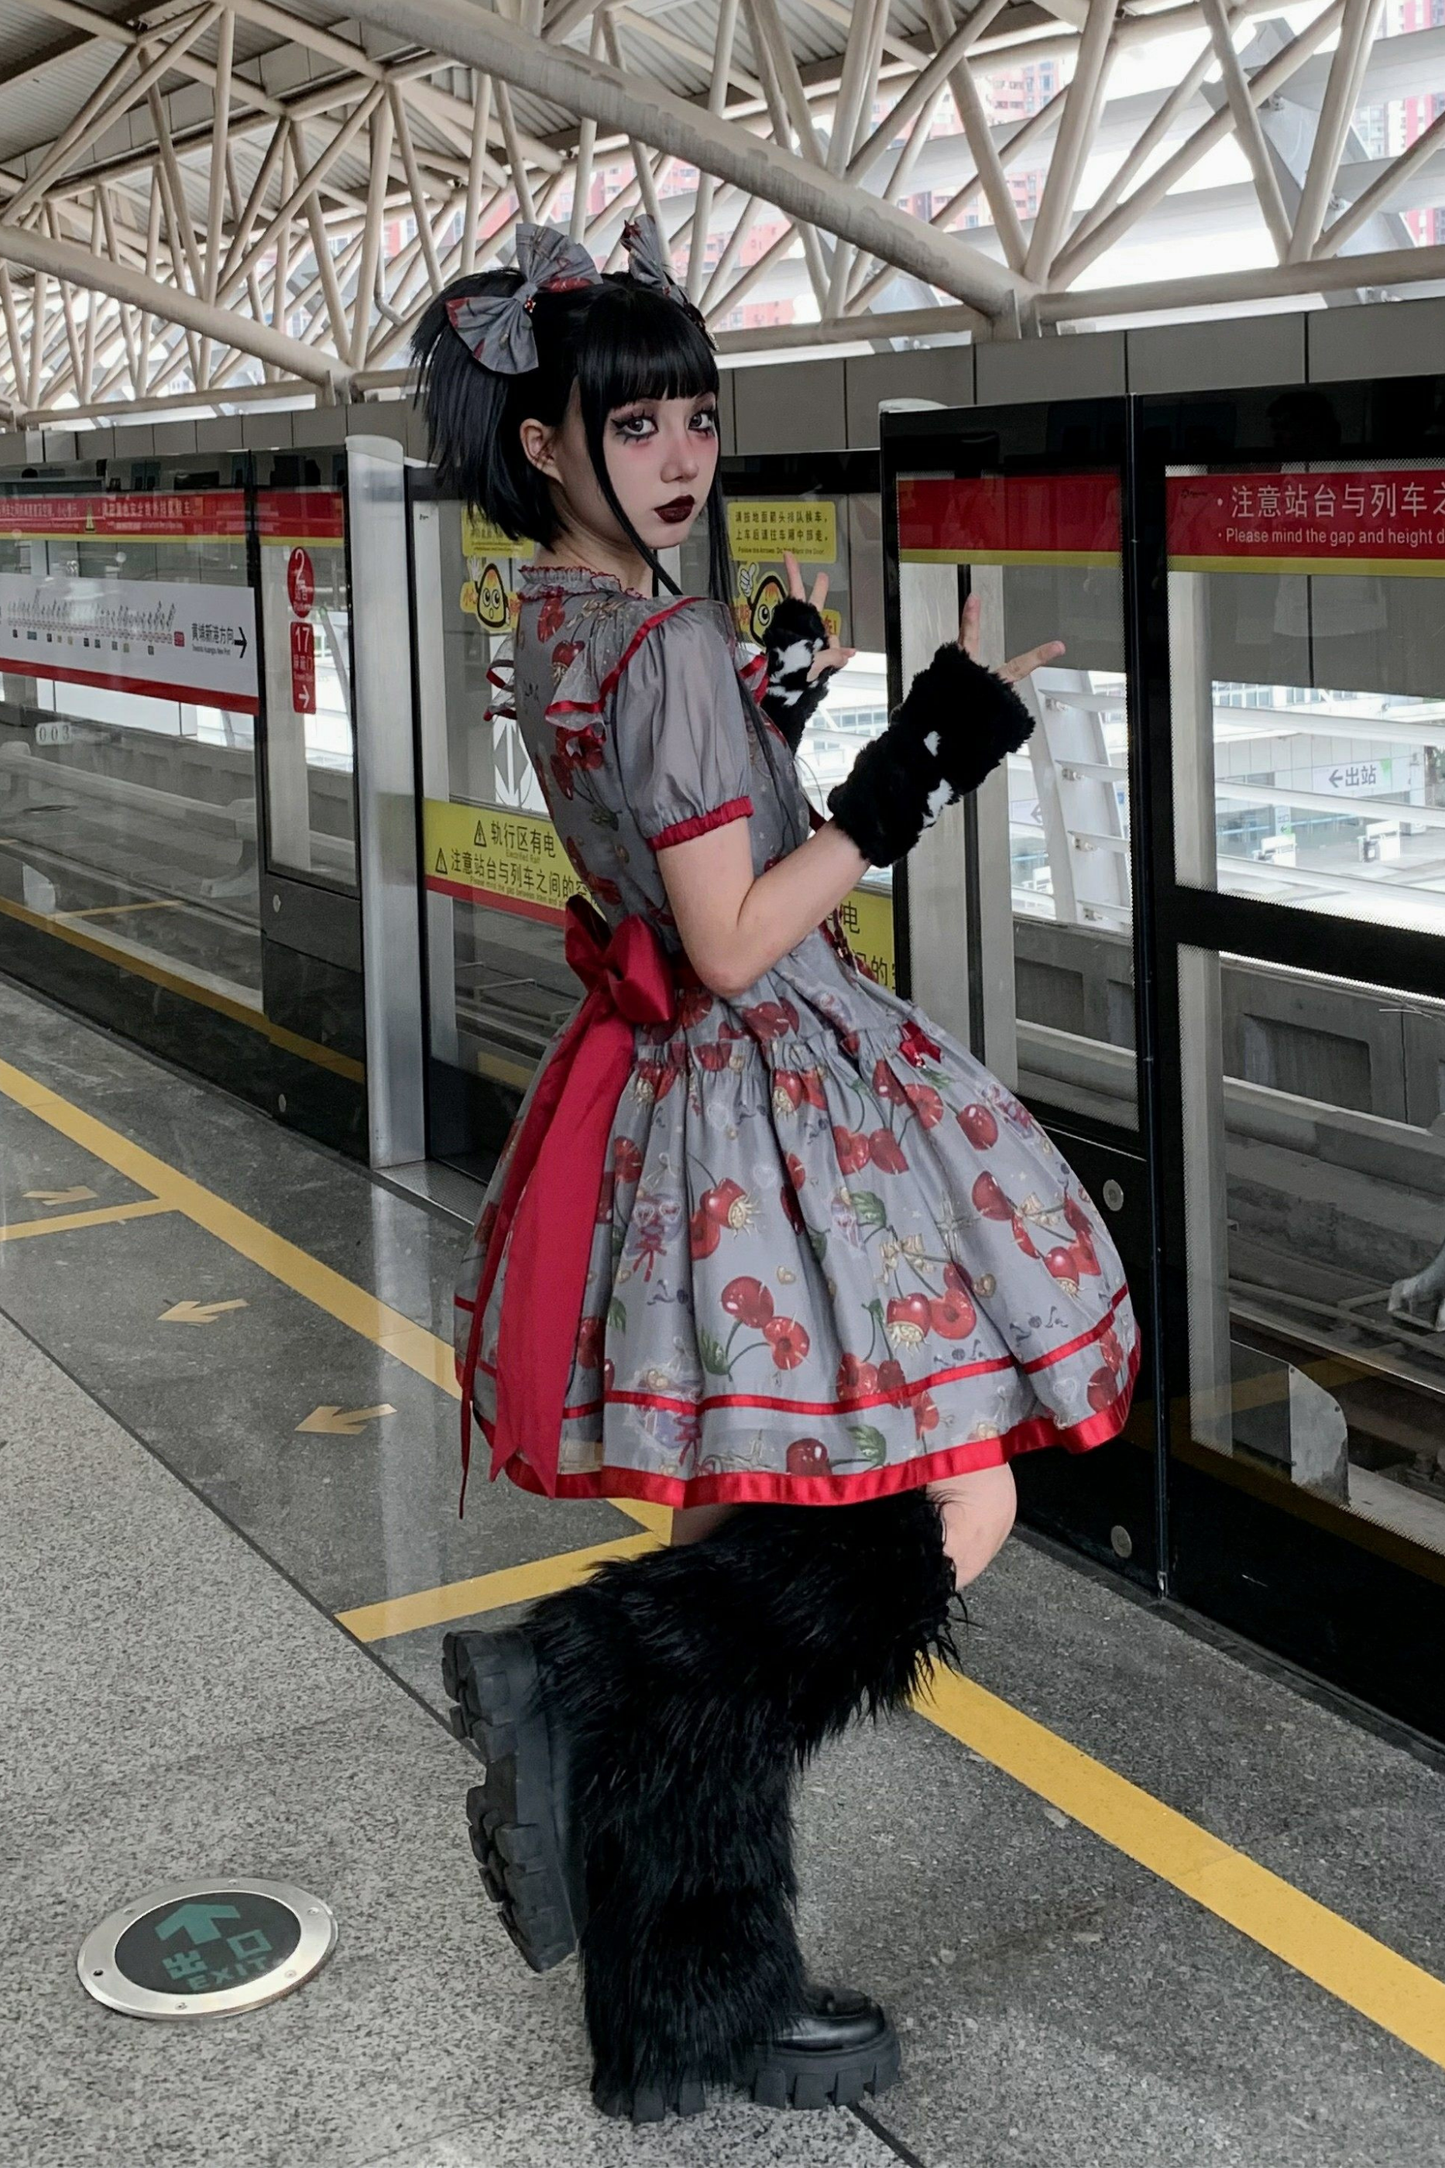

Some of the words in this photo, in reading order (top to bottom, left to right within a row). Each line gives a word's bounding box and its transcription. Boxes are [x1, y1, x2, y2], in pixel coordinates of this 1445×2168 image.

[1226, 527, 1268, 543] Please
[1272, 528, 1303, 543] mind
[1306, 528, 1326, 543] the
[1330, 531, 1355, 547] gap
[1359, 528, 1384, 543] and
[1388, 528, 1433, 548] height
[295, 549, 305, 584] 2
[295, 626, 310, 653] 17
[39, 725, 70, 742] 003
[1345, 764, 1377, 787] 出站
[491, 821, 556, 858] 轨行区有电
[832, 901, 861, 934] 电
[161, 1929, 273, 1980] 出口
[186, 1956, 270, 1991] EXIT
